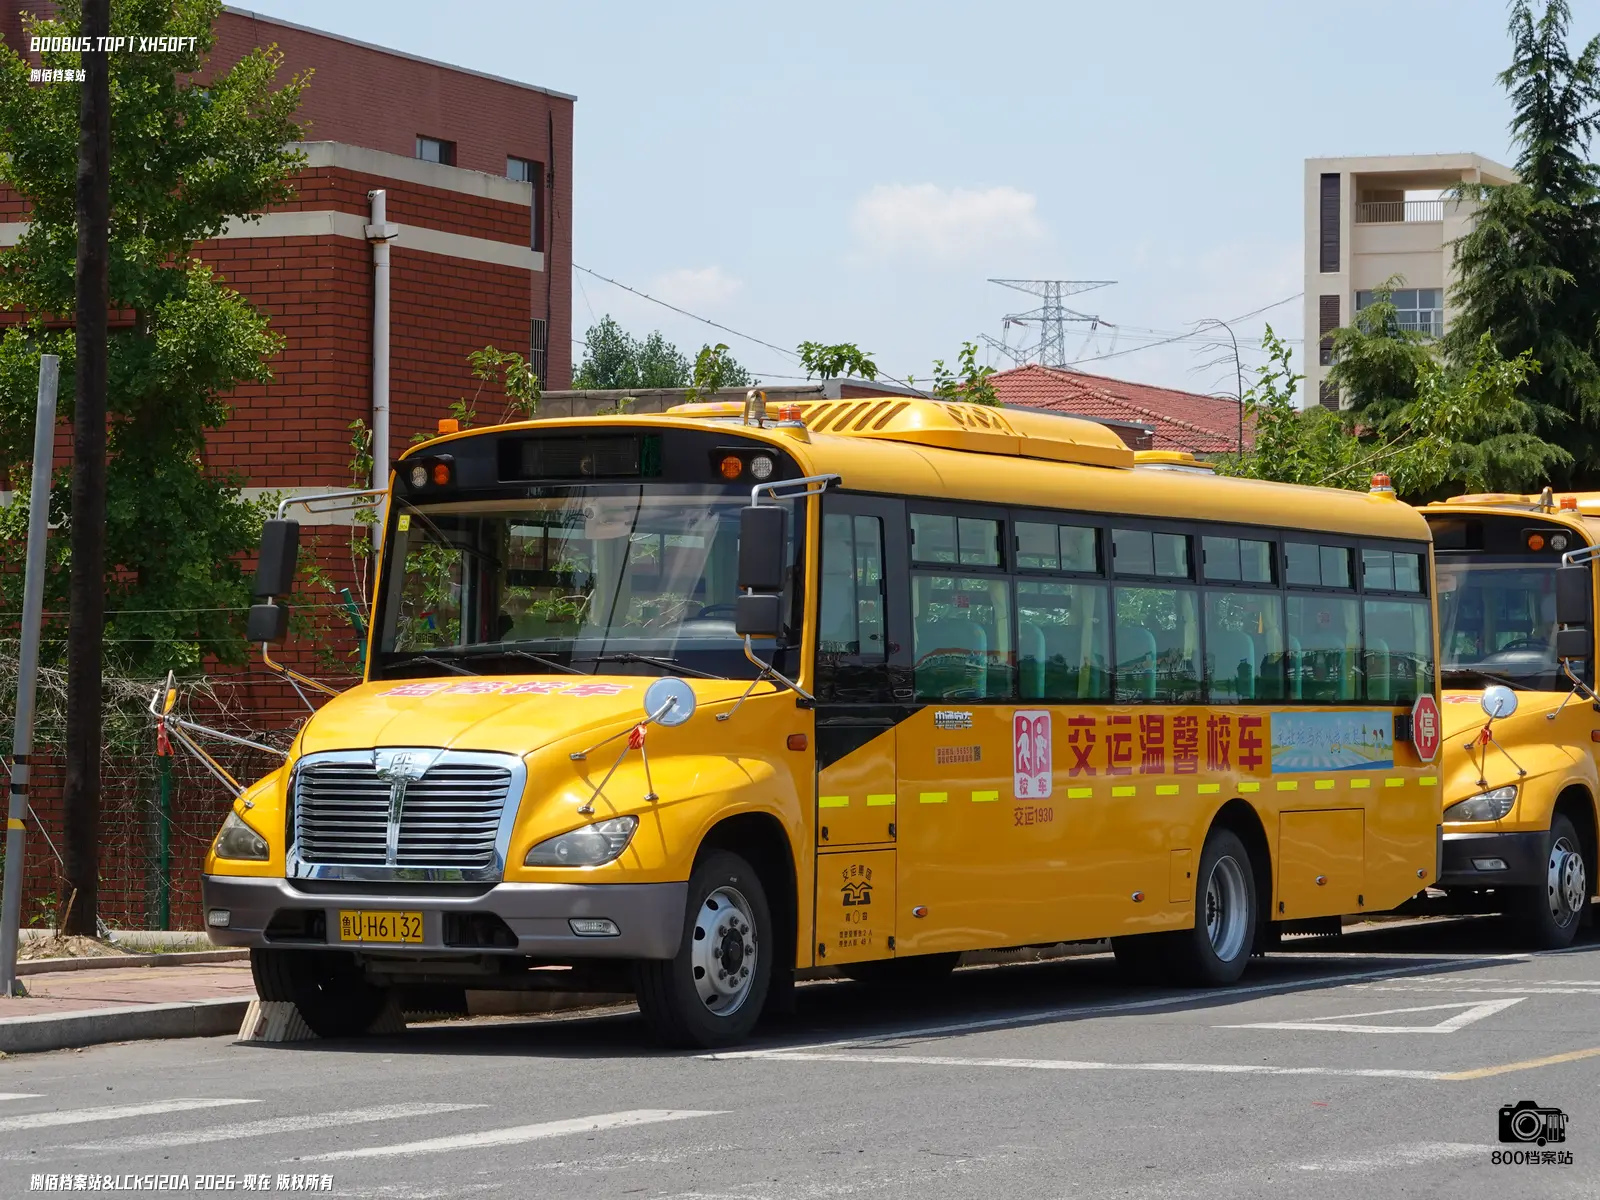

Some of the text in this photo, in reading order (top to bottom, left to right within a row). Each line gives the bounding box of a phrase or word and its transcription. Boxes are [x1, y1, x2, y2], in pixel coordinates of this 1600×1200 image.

[1419, 707, 1435, 748] 停
[1067, 714, 1263, 778] 交运温馨校车
[1018, 776, 1048, 795] 校车
[1013, 804, 1054, 827] 交运1930
